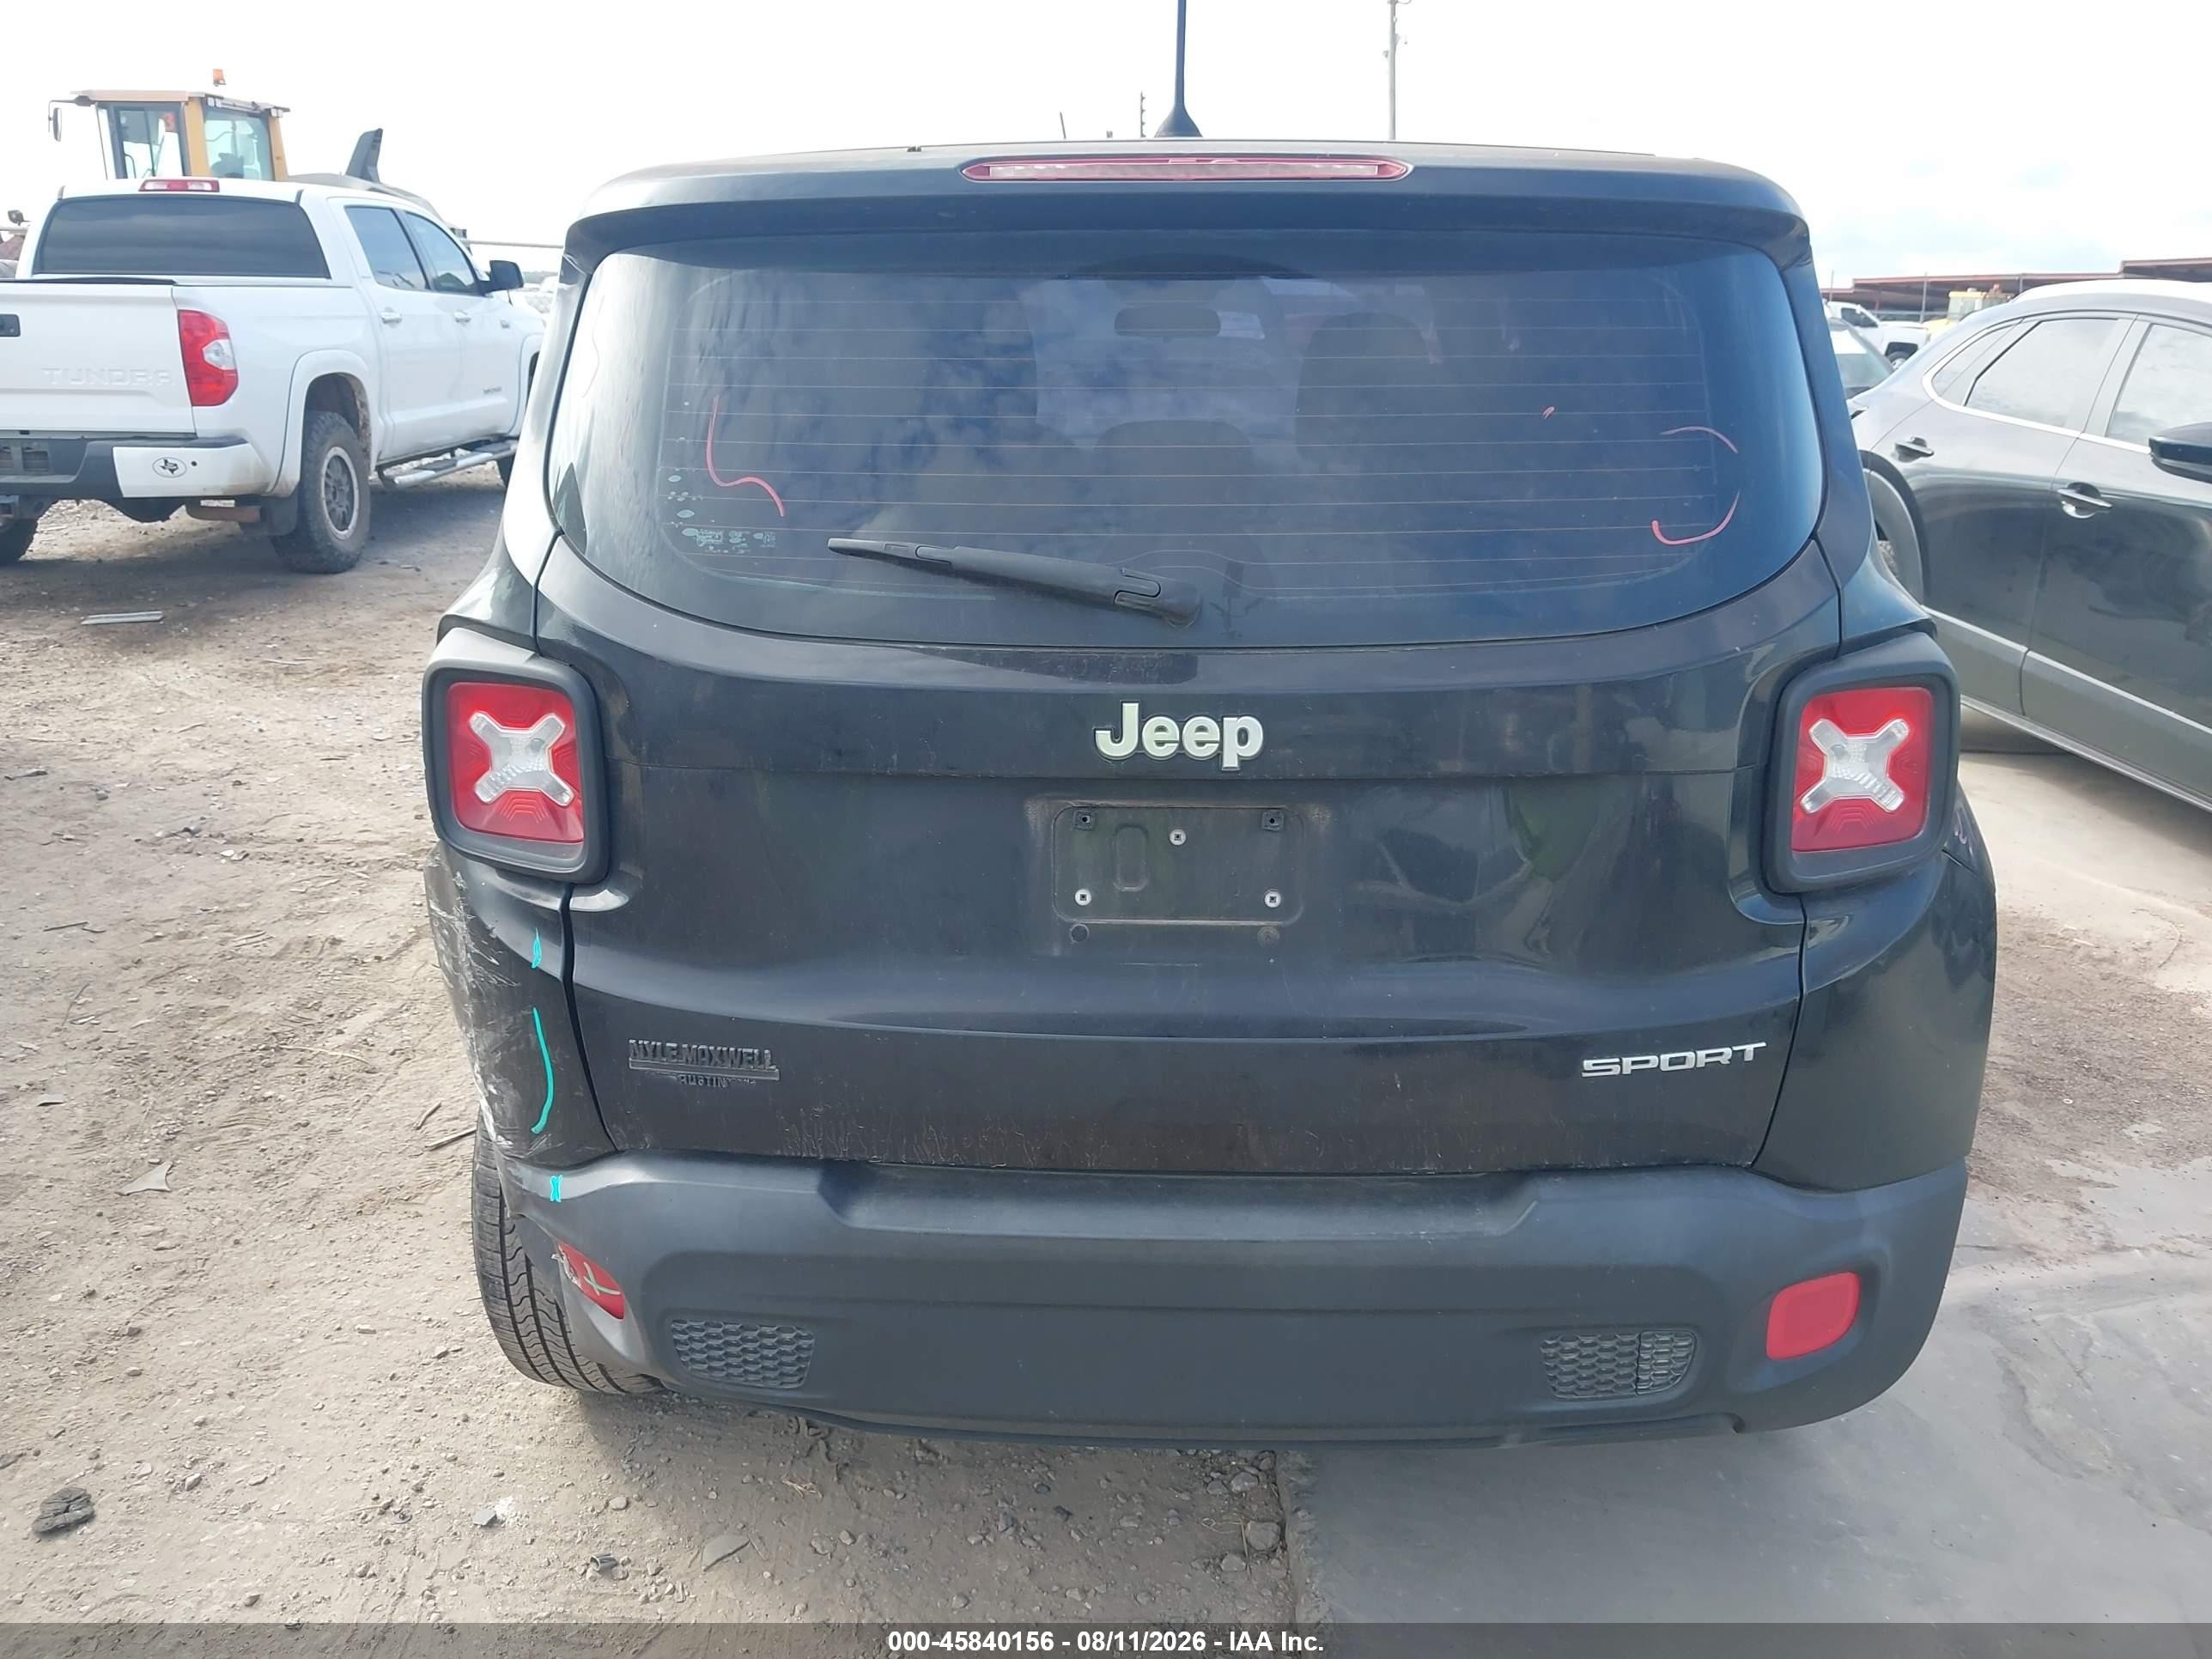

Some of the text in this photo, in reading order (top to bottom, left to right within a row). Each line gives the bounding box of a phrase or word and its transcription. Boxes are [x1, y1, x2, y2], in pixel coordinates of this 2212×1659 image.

[41, 368, 174, 386] TUNDRA
[1094, 702, 1264, 770] Jeep
[628, 1038, 777, 1070] NYLE MAXWELL
[1581, 1042, 1767, 1078] SPORT
